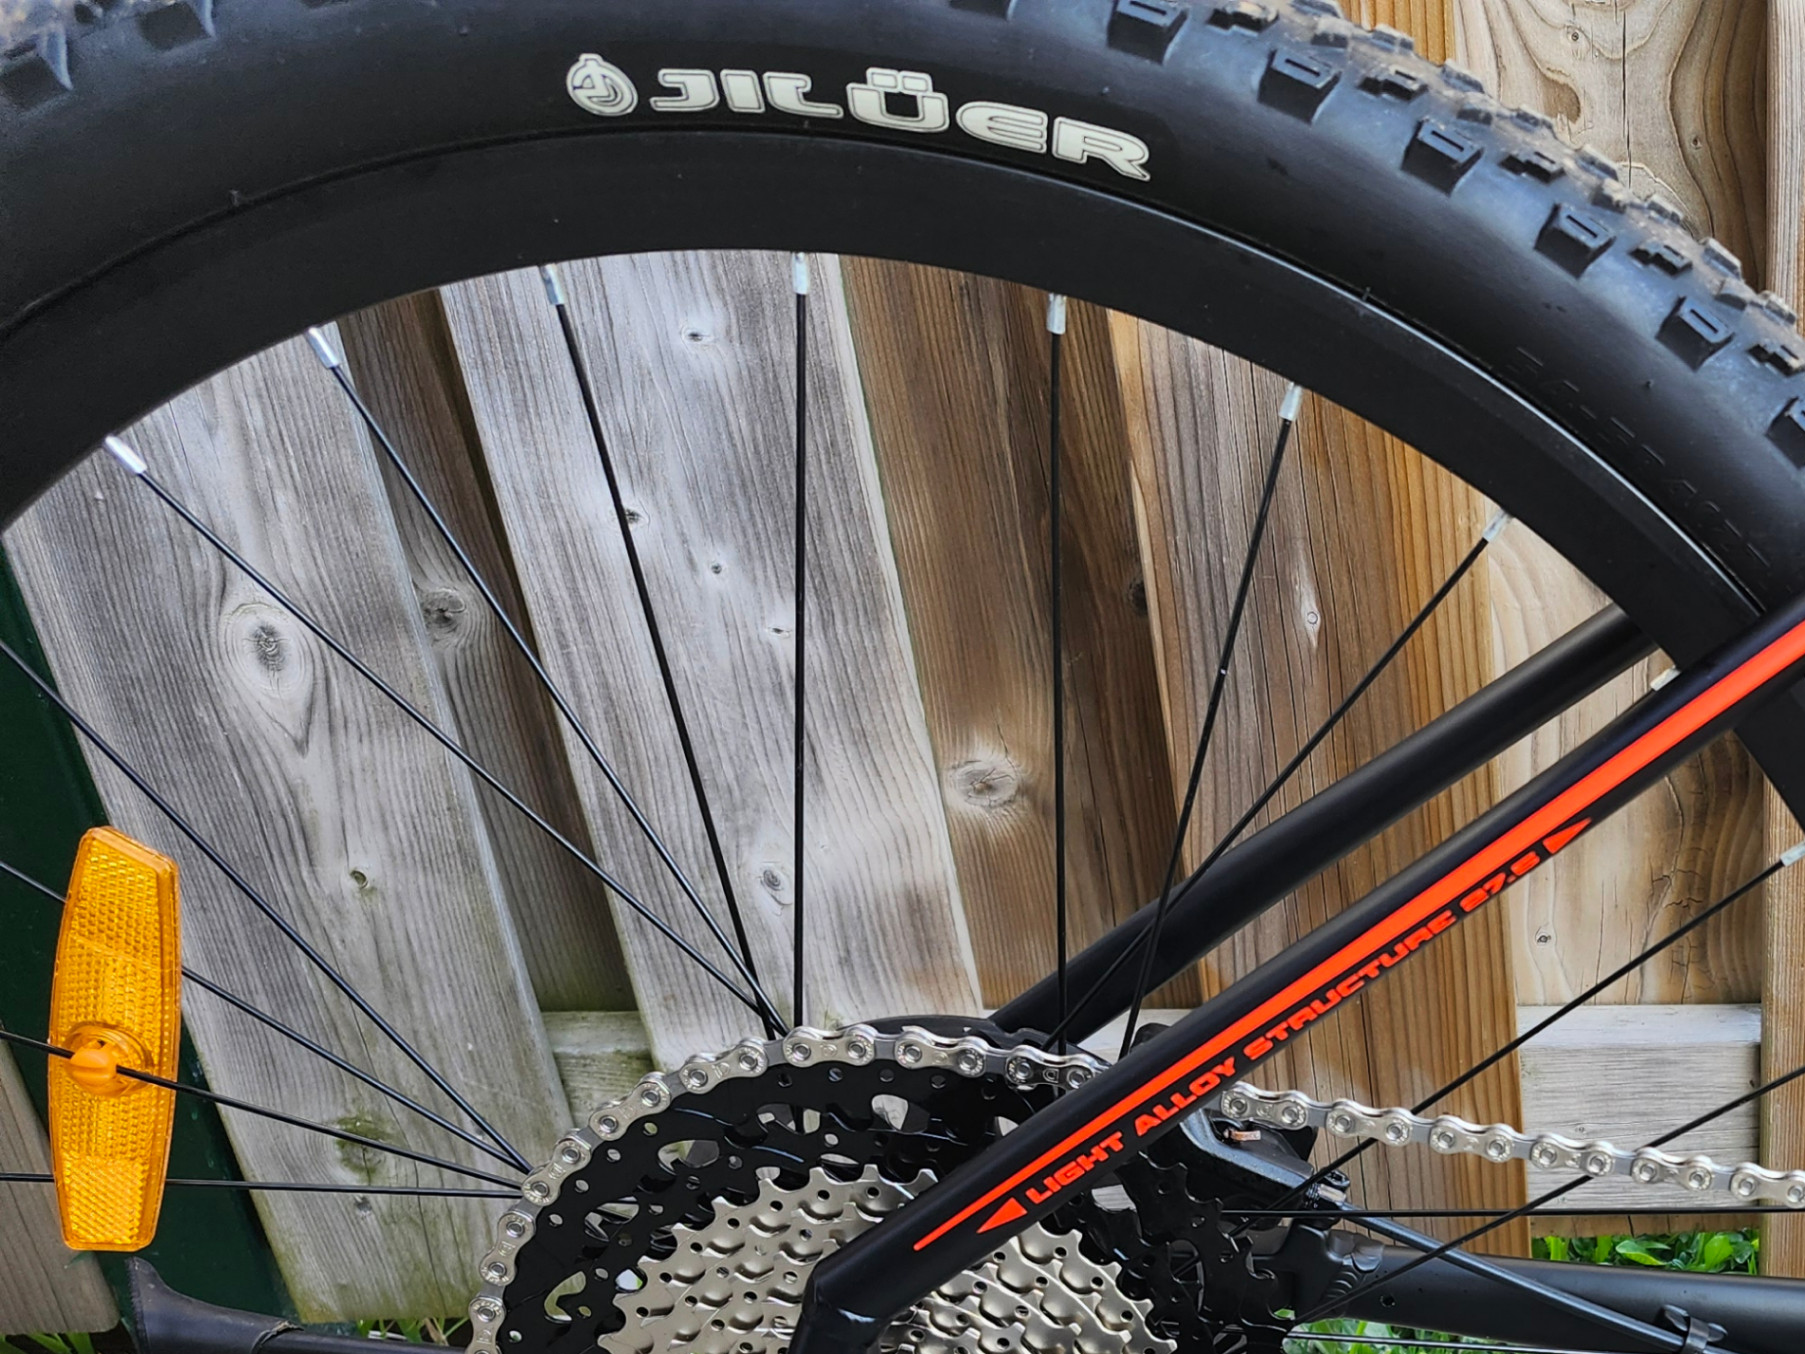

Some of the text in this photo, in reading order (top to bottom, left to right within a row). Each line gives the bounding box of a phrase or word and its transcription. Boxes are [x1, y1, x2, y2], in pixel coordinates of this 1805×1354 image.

[1025, 1131, 1126, 1204] LIGHT
[1134, 1056, 1236, 1137] ALLOY
[1243, 909, 1457, 1060] STRUCTURE
